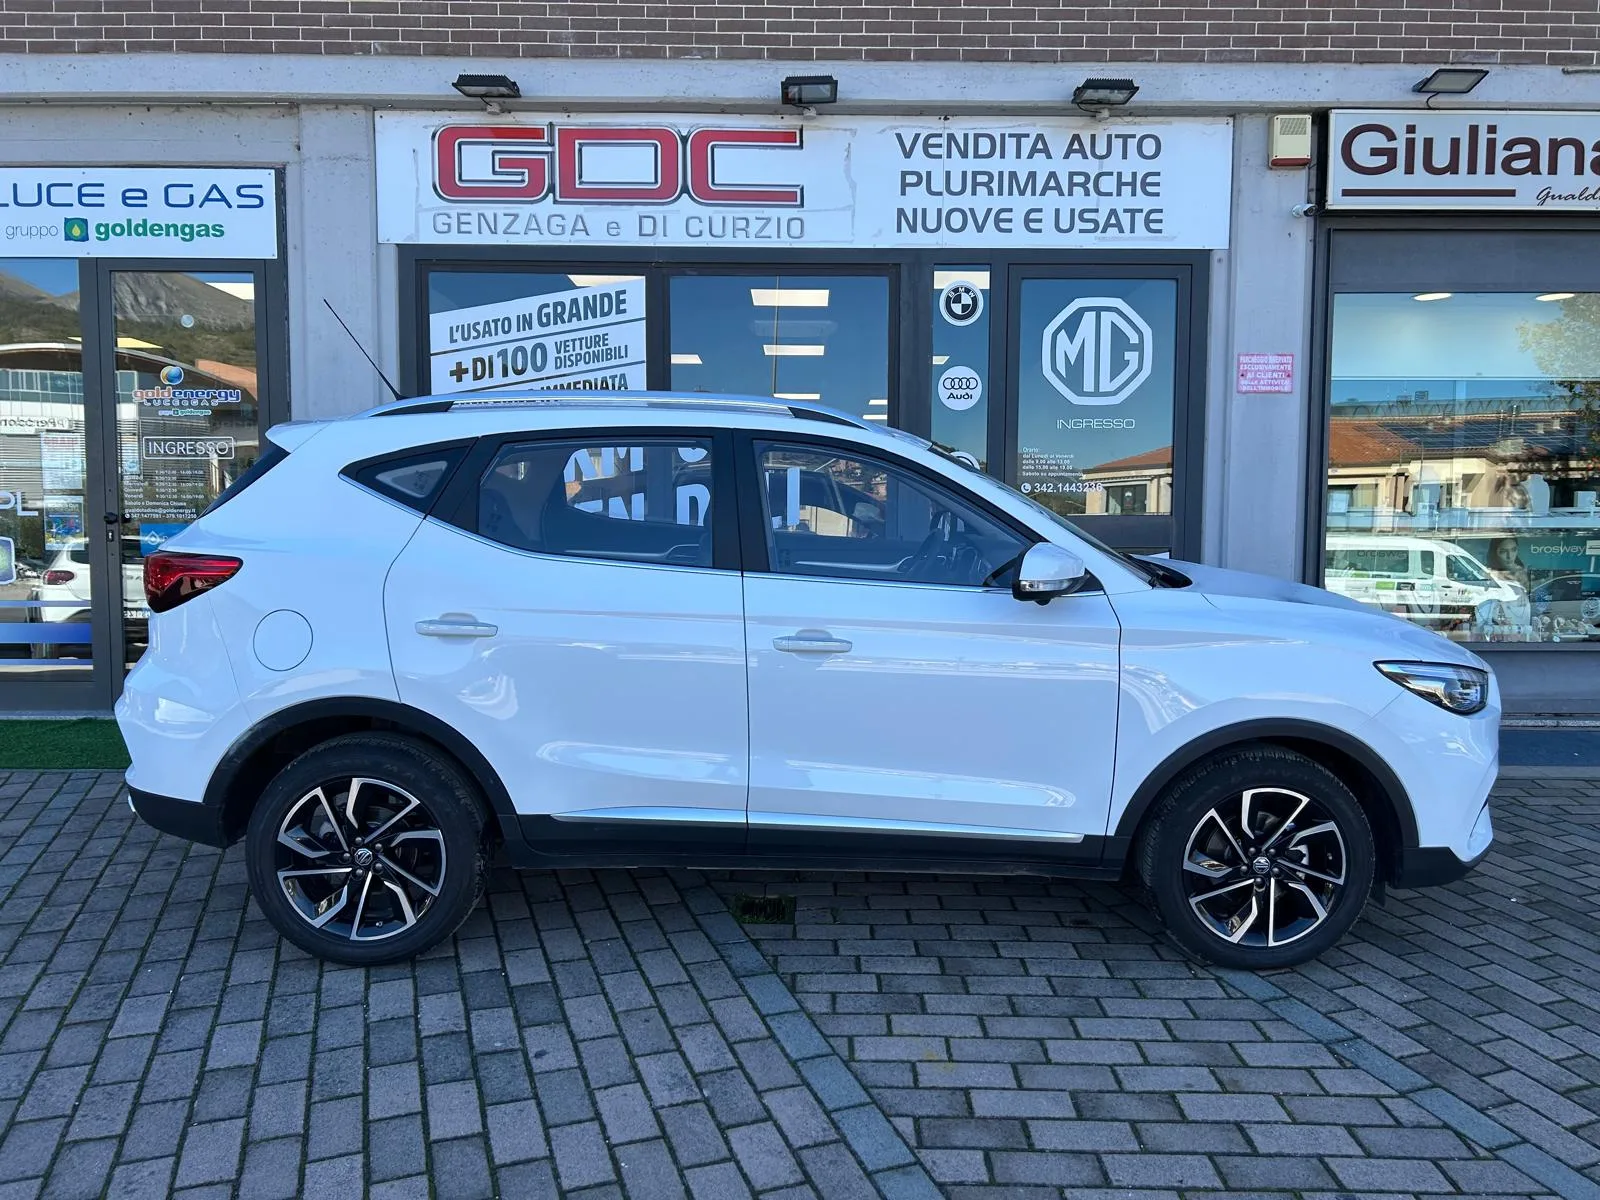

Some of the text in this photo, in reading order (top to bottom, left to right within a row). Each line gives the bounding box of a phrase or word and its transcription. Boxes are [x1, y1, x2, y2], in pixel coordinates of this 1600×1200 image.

[895, 132, 1162, 160] VENDITA AUTO
[1341, 123, 1600, 176] Giulian
[432, 122, 804, 207] GDC
[0, 183, 264, 209] UCE e GAS
[900, 170, 1161, 197] PLURIMARCHE
[1536, 186, 1600, 206] Guald
[5, 219, 225, 242] gruppo goldengas
[432, 212, 806, 239] GENZAGA e DI CURZIO
[896, 207, 1163, 234] NUOVE E USATE
[450, 289, 627, 343] L'USATO IN GRANDE
[554, 333, 609, 354] VETTURE
[1056, 311, 1139, 392] MG
[497, 342, 548, 378] 100
[554, 345, 629, 370] DISPONIBILI
[132, 386, 242, 402] goldenergy
[541, 373, 629, 391] EDIATA
[1056, 419, 1135, 429] INGRESSO
[149, 441, 229, 455] INGRESSO
[1034, 482, 1103, 493] 342.1443236
[1531, 544, 1585, 556] brosway
